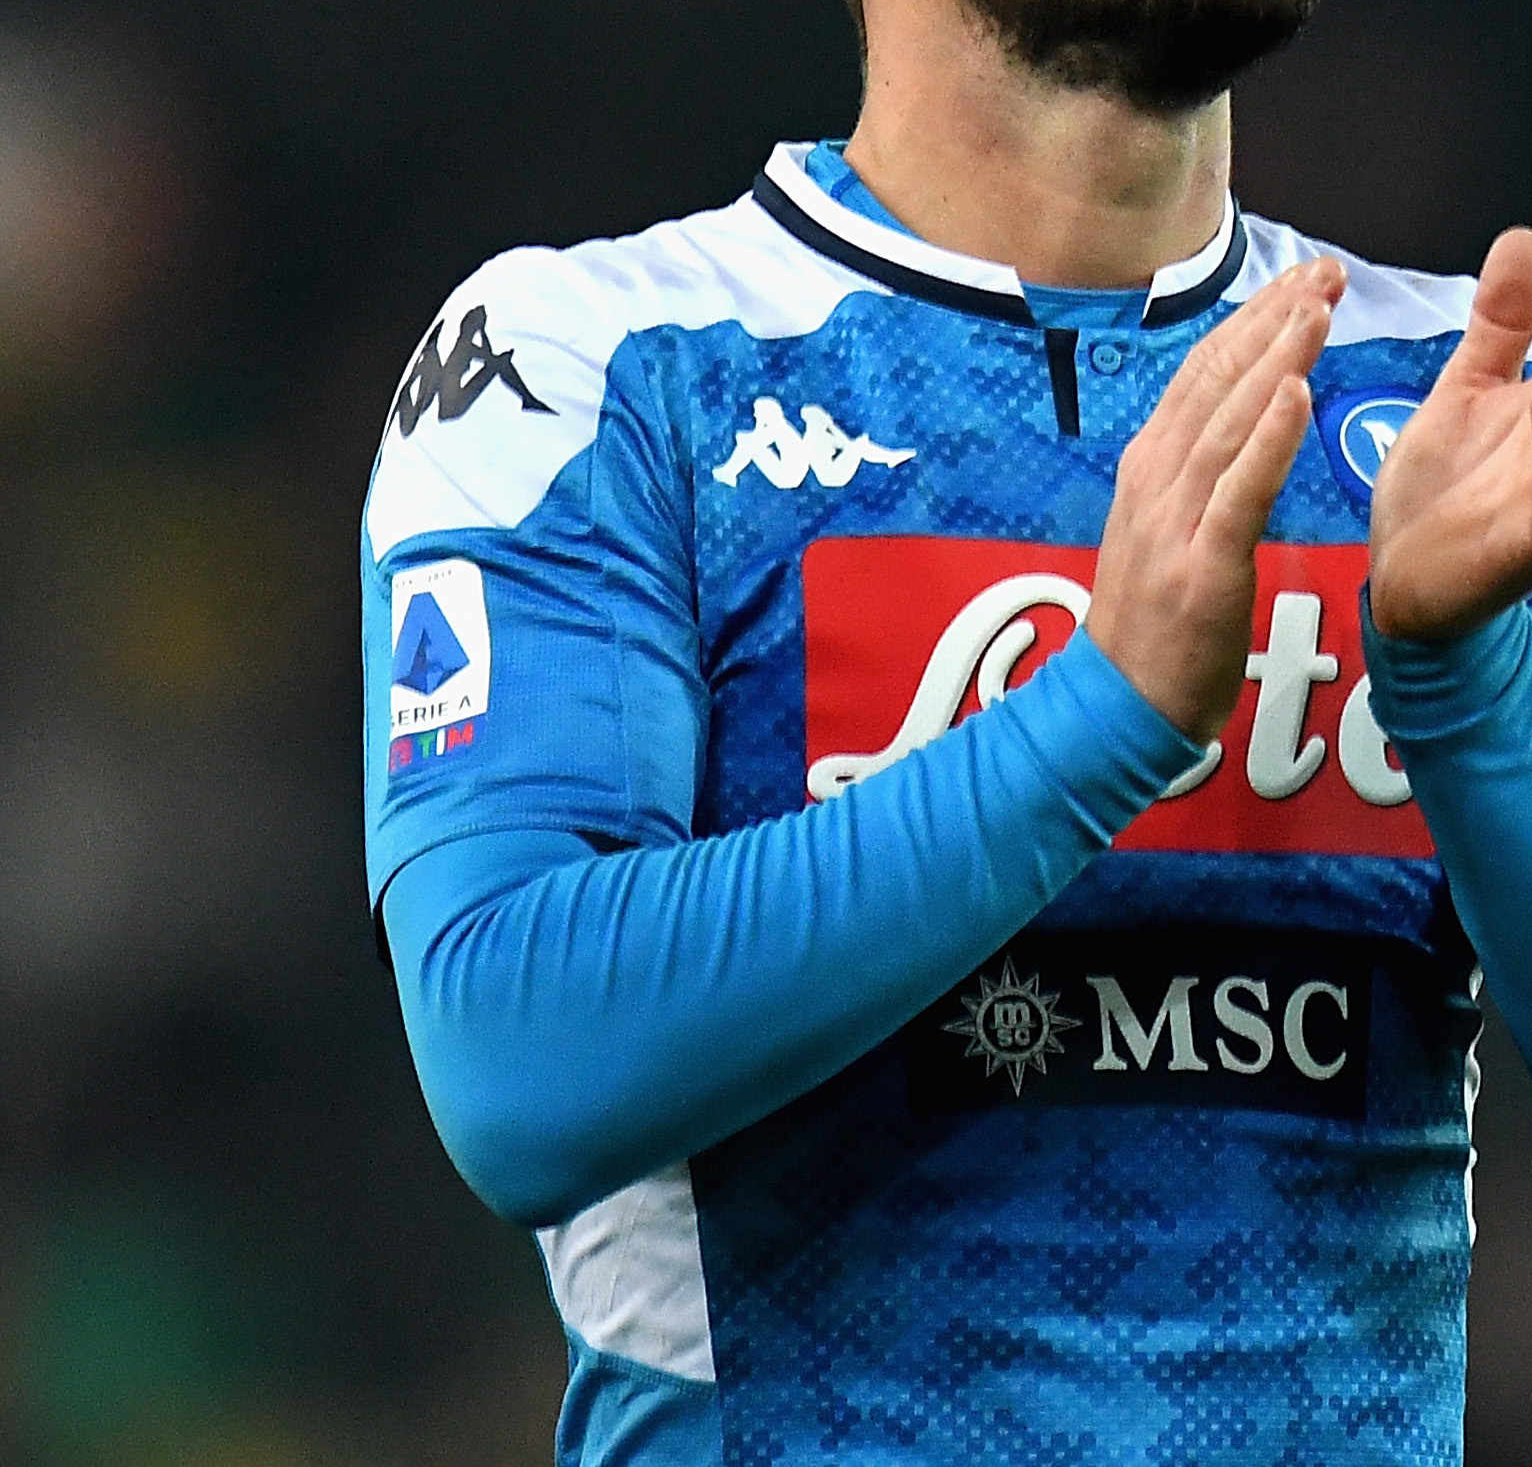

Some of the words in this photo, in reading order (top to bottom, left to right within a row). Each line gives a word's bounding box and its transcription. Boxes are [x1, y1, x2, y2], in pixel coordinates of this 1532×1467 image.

[391, 701, 449, 727] ERIE
[459, 695, 472, 710] A
[418, 723, 474, 758] TIM
[1086, 975, 1348, 1080] MSC
